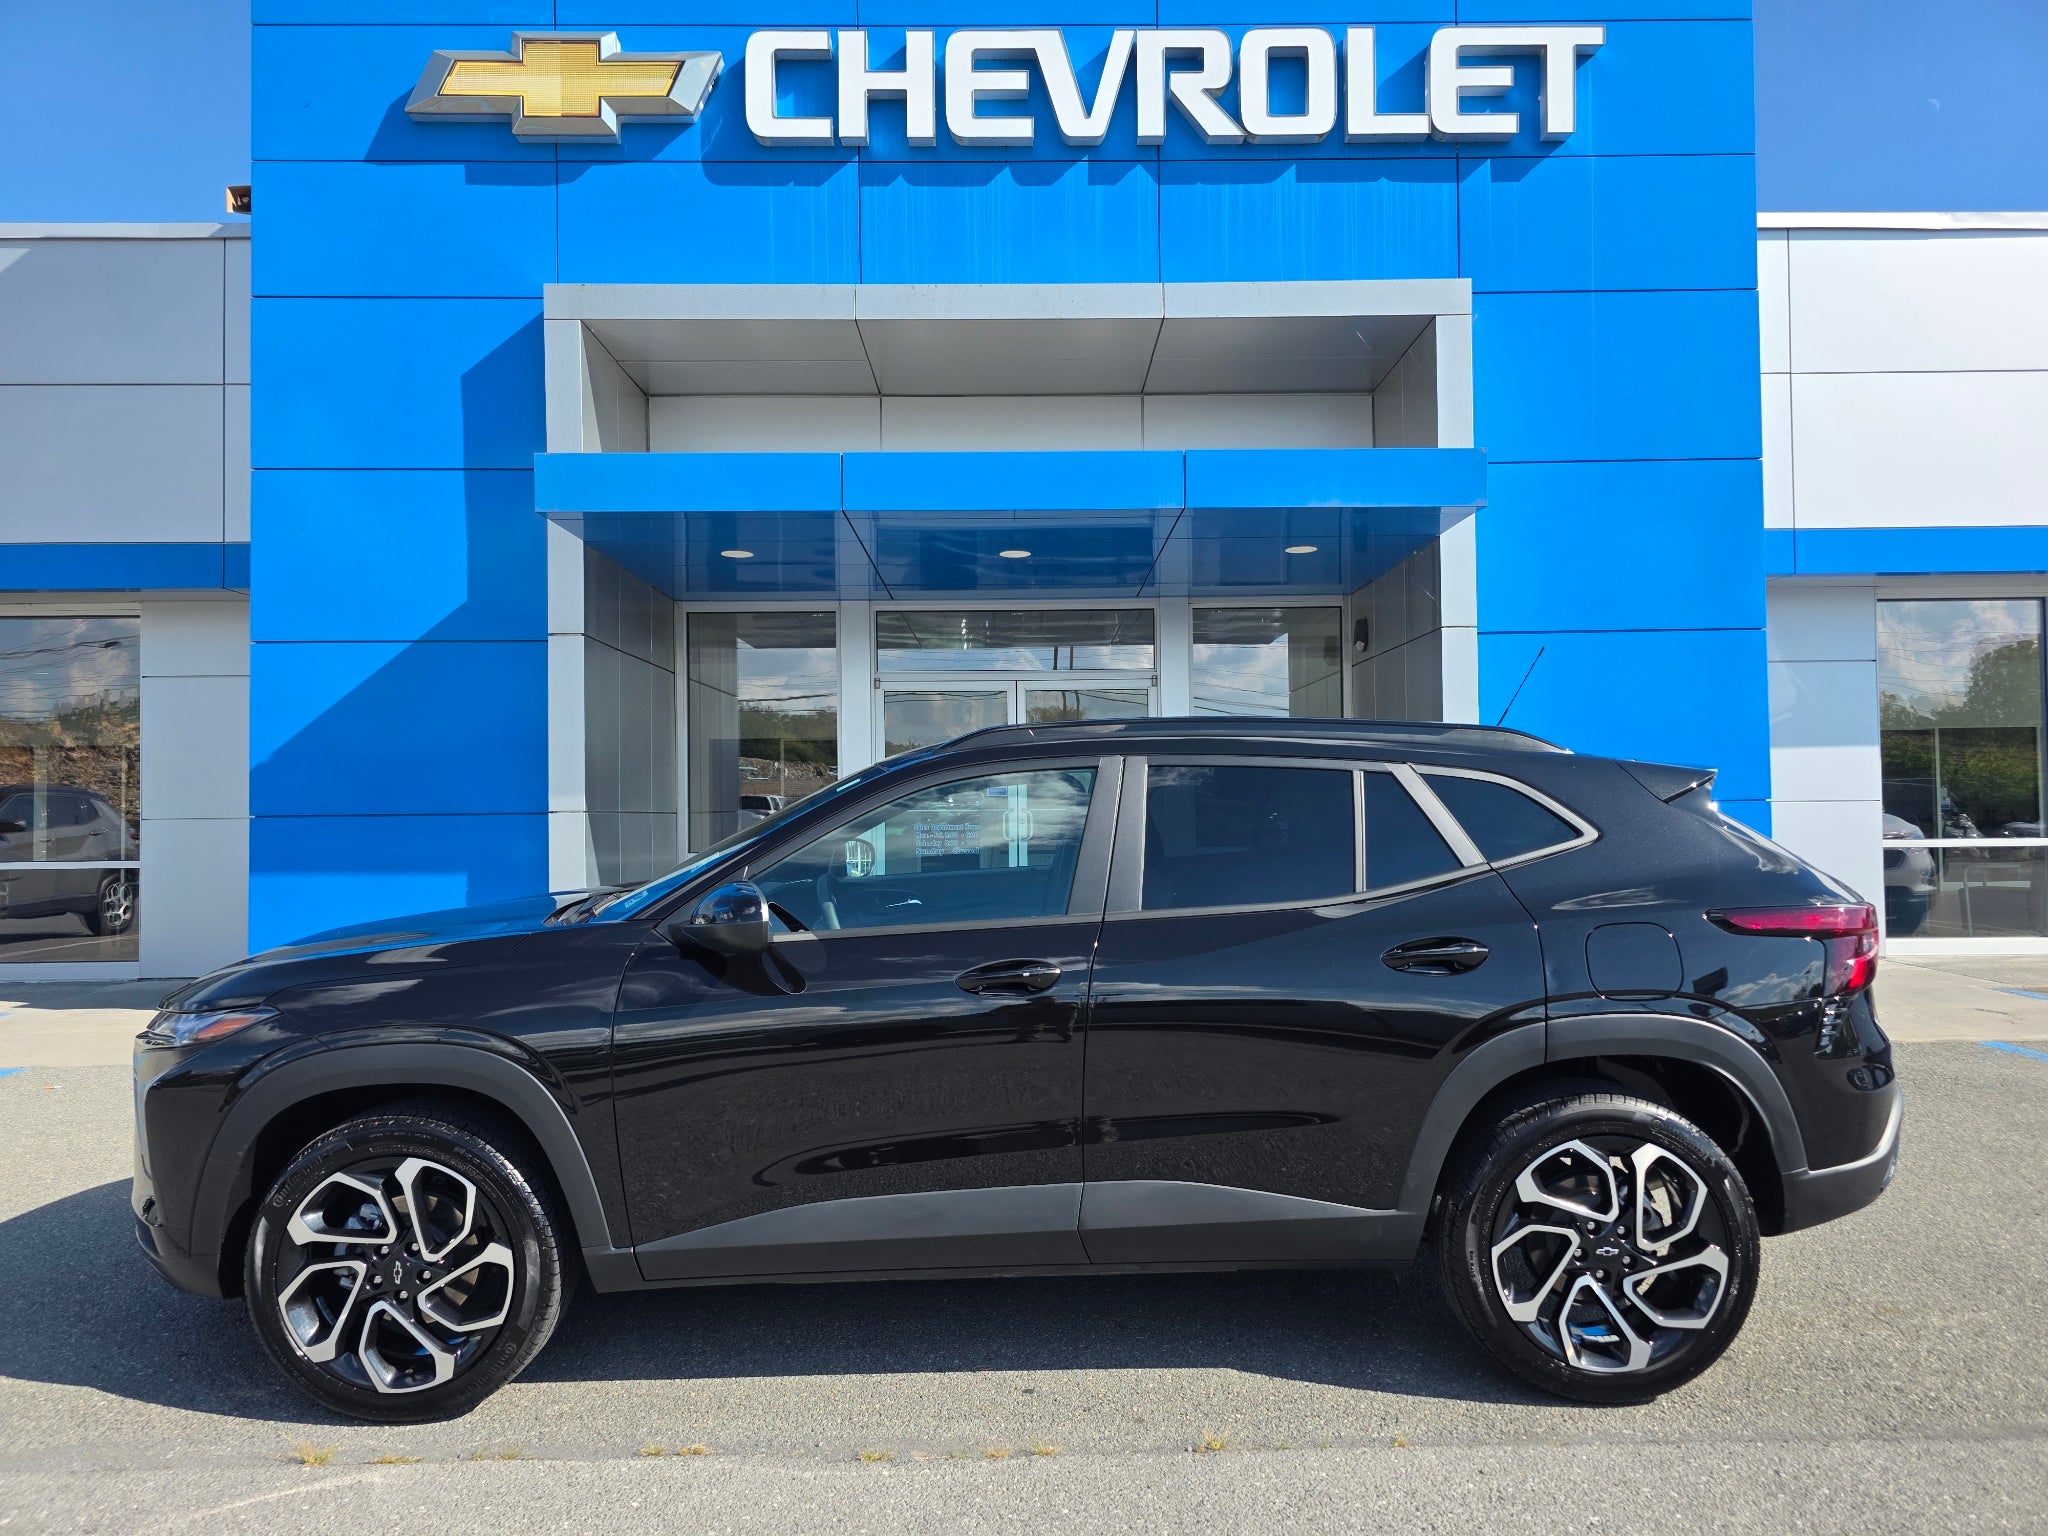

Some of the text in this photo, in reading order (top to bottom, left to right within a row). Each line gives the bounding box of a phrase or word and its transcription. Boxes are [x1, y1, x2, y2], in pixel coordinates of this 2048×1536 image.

[745, 26, 1606, 147] CHEVROLET
[915, 846, 980, 856] Sunday Closed
